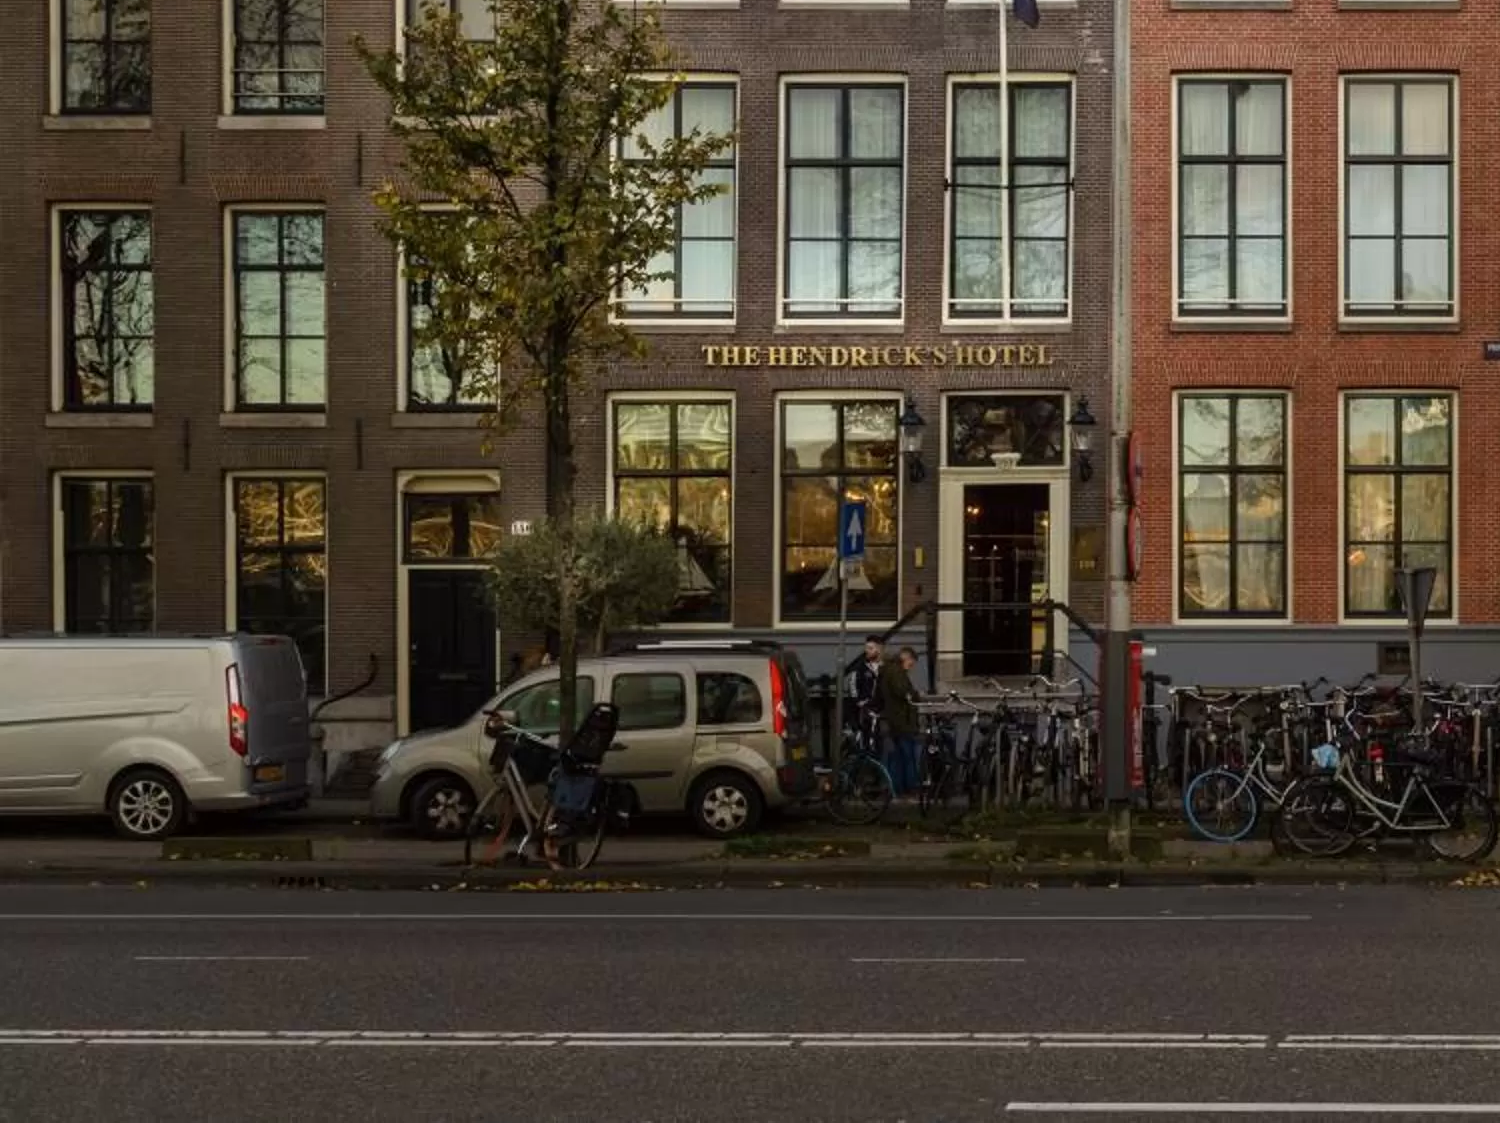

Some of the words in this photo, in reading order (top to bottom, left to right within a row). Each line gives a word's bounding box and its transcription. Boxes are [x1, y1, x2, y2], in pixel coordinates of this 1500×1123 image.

[701, 344, 760, 366] THE
[767, 344, 947, 366] HENDRICK'S
[954, 344, 1053, 366] HOTEL
